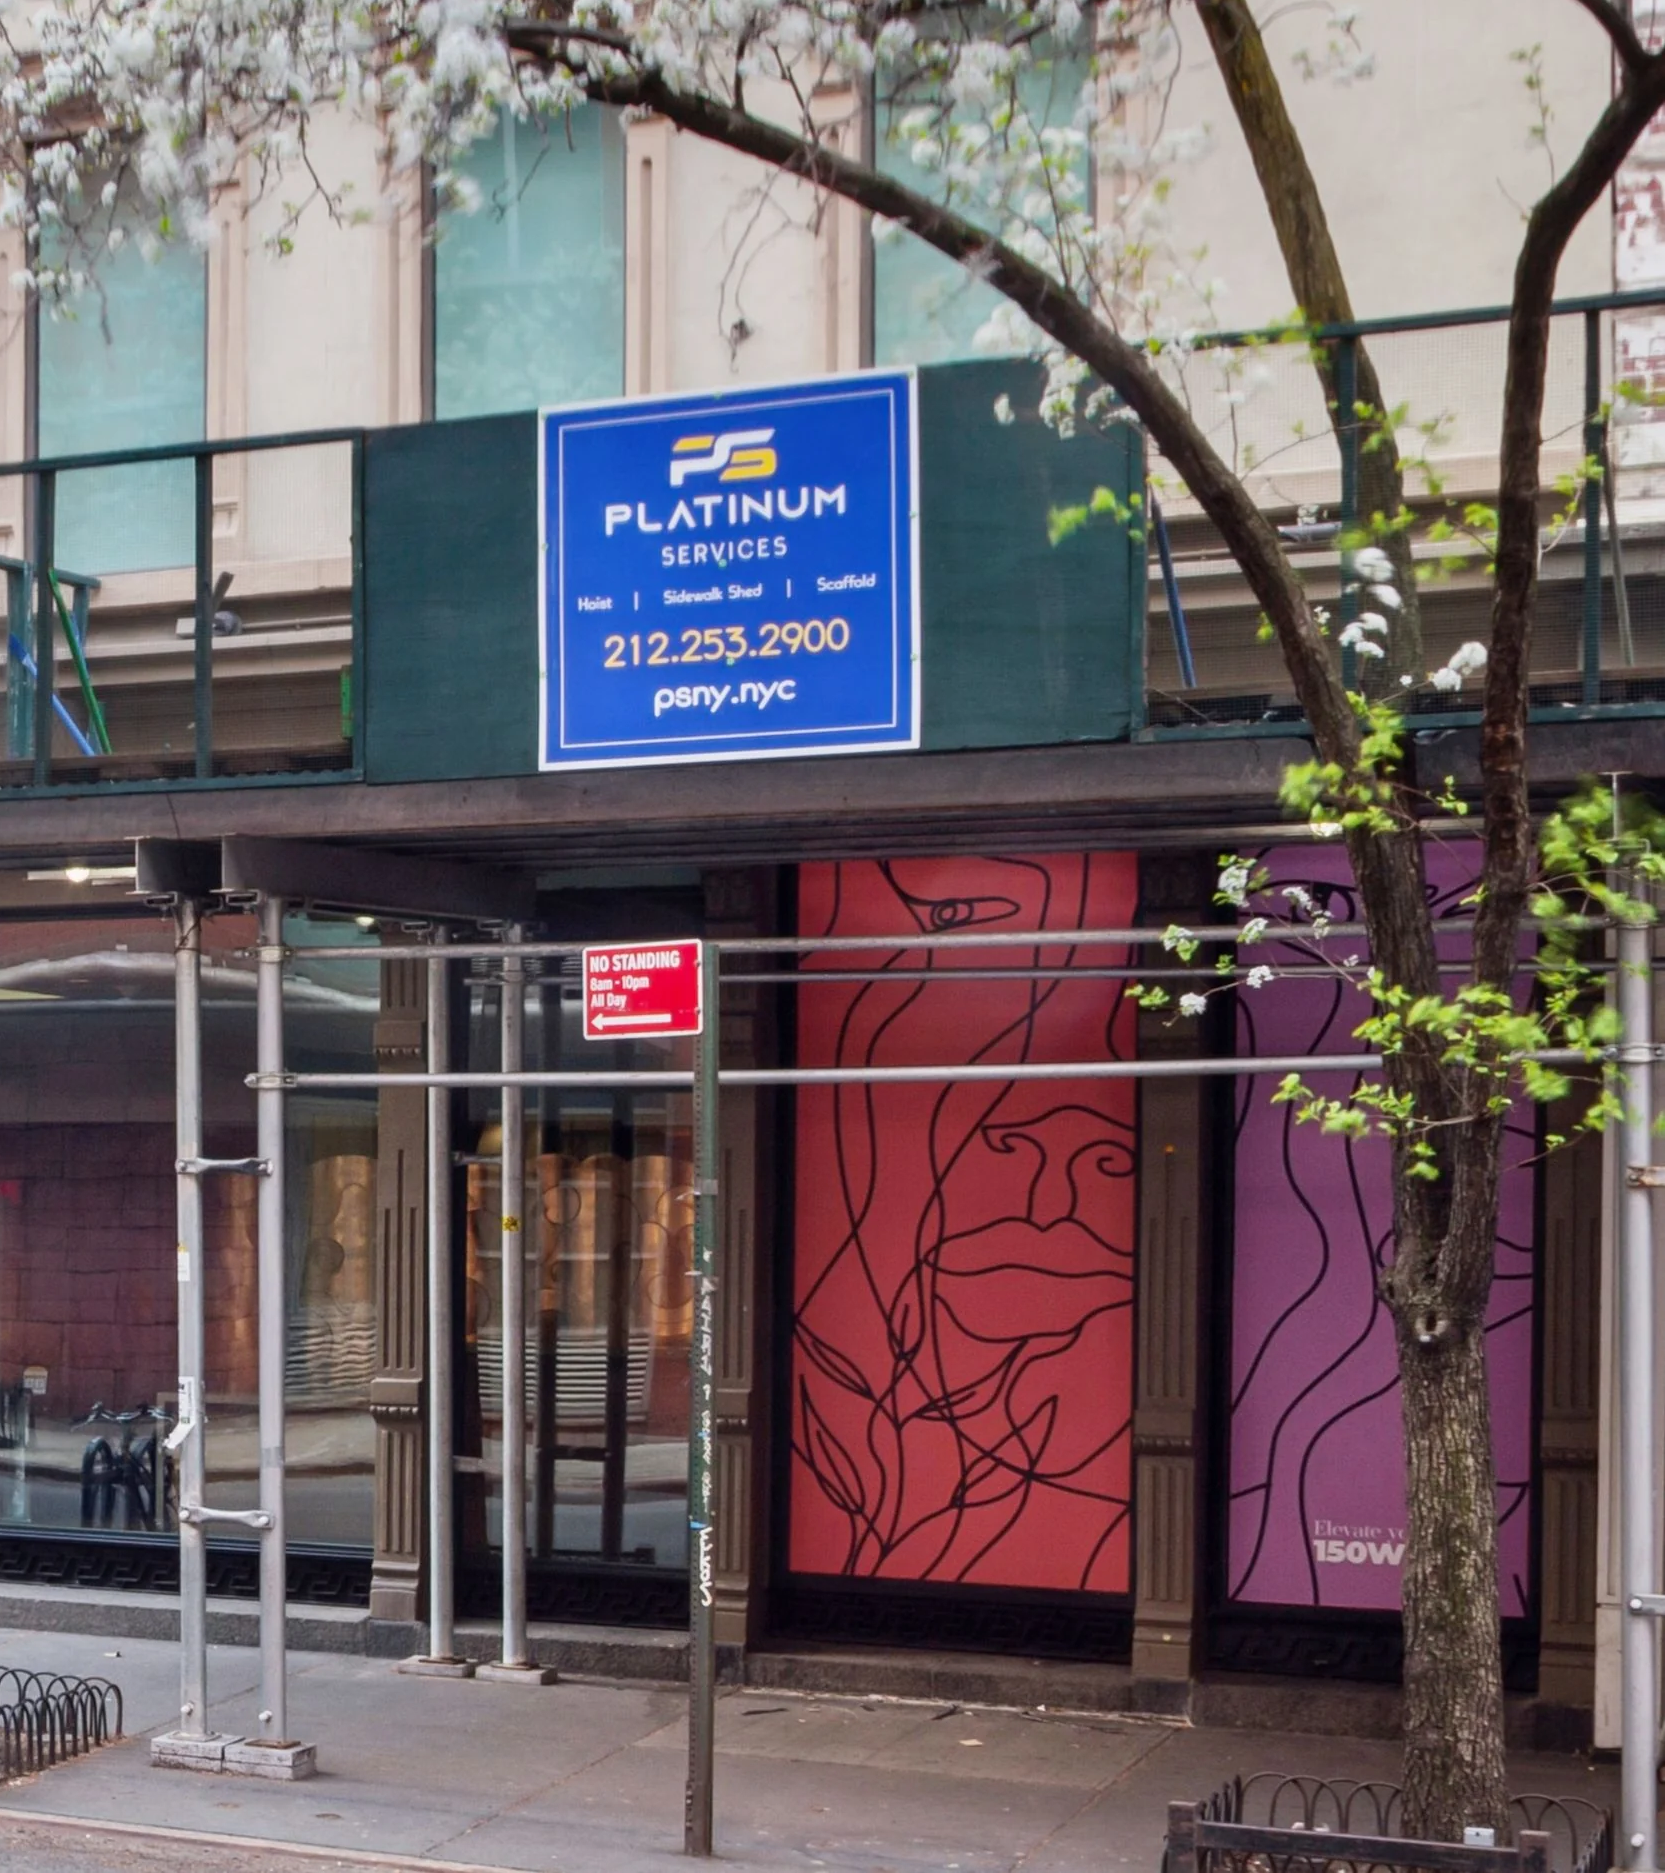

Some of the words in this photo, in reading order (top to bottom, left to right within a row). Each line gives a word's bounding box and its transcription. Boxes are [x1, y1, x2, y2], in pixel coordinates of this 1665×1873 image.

[604, 483, 847, 537] PLATINUM
[661, 535, 788, 567] SERVICES
[577, 596, 613, 612] Hoist
[663, 586, 723, 605] Sidewalk
[727, 583, 763, 600] Shed
[816, 573, 877, 592] Scaffold
[603, 617, 850, 668] 212.253.2900
[653, 679, 797, 718] psny.nyc
[589, 956, 610, 973] NO
[612, 950, 681, 972] STANDING
[590, 977, 613, 991] 8am
[621, 975, 650, 992] 10pm
[590, 993, 605, 1008] All
[606, 992, 627, 1009] Day
[1314, 1520, 1382, 1539] Elevate
[1313, 1539, 1405, 1566] 150W
